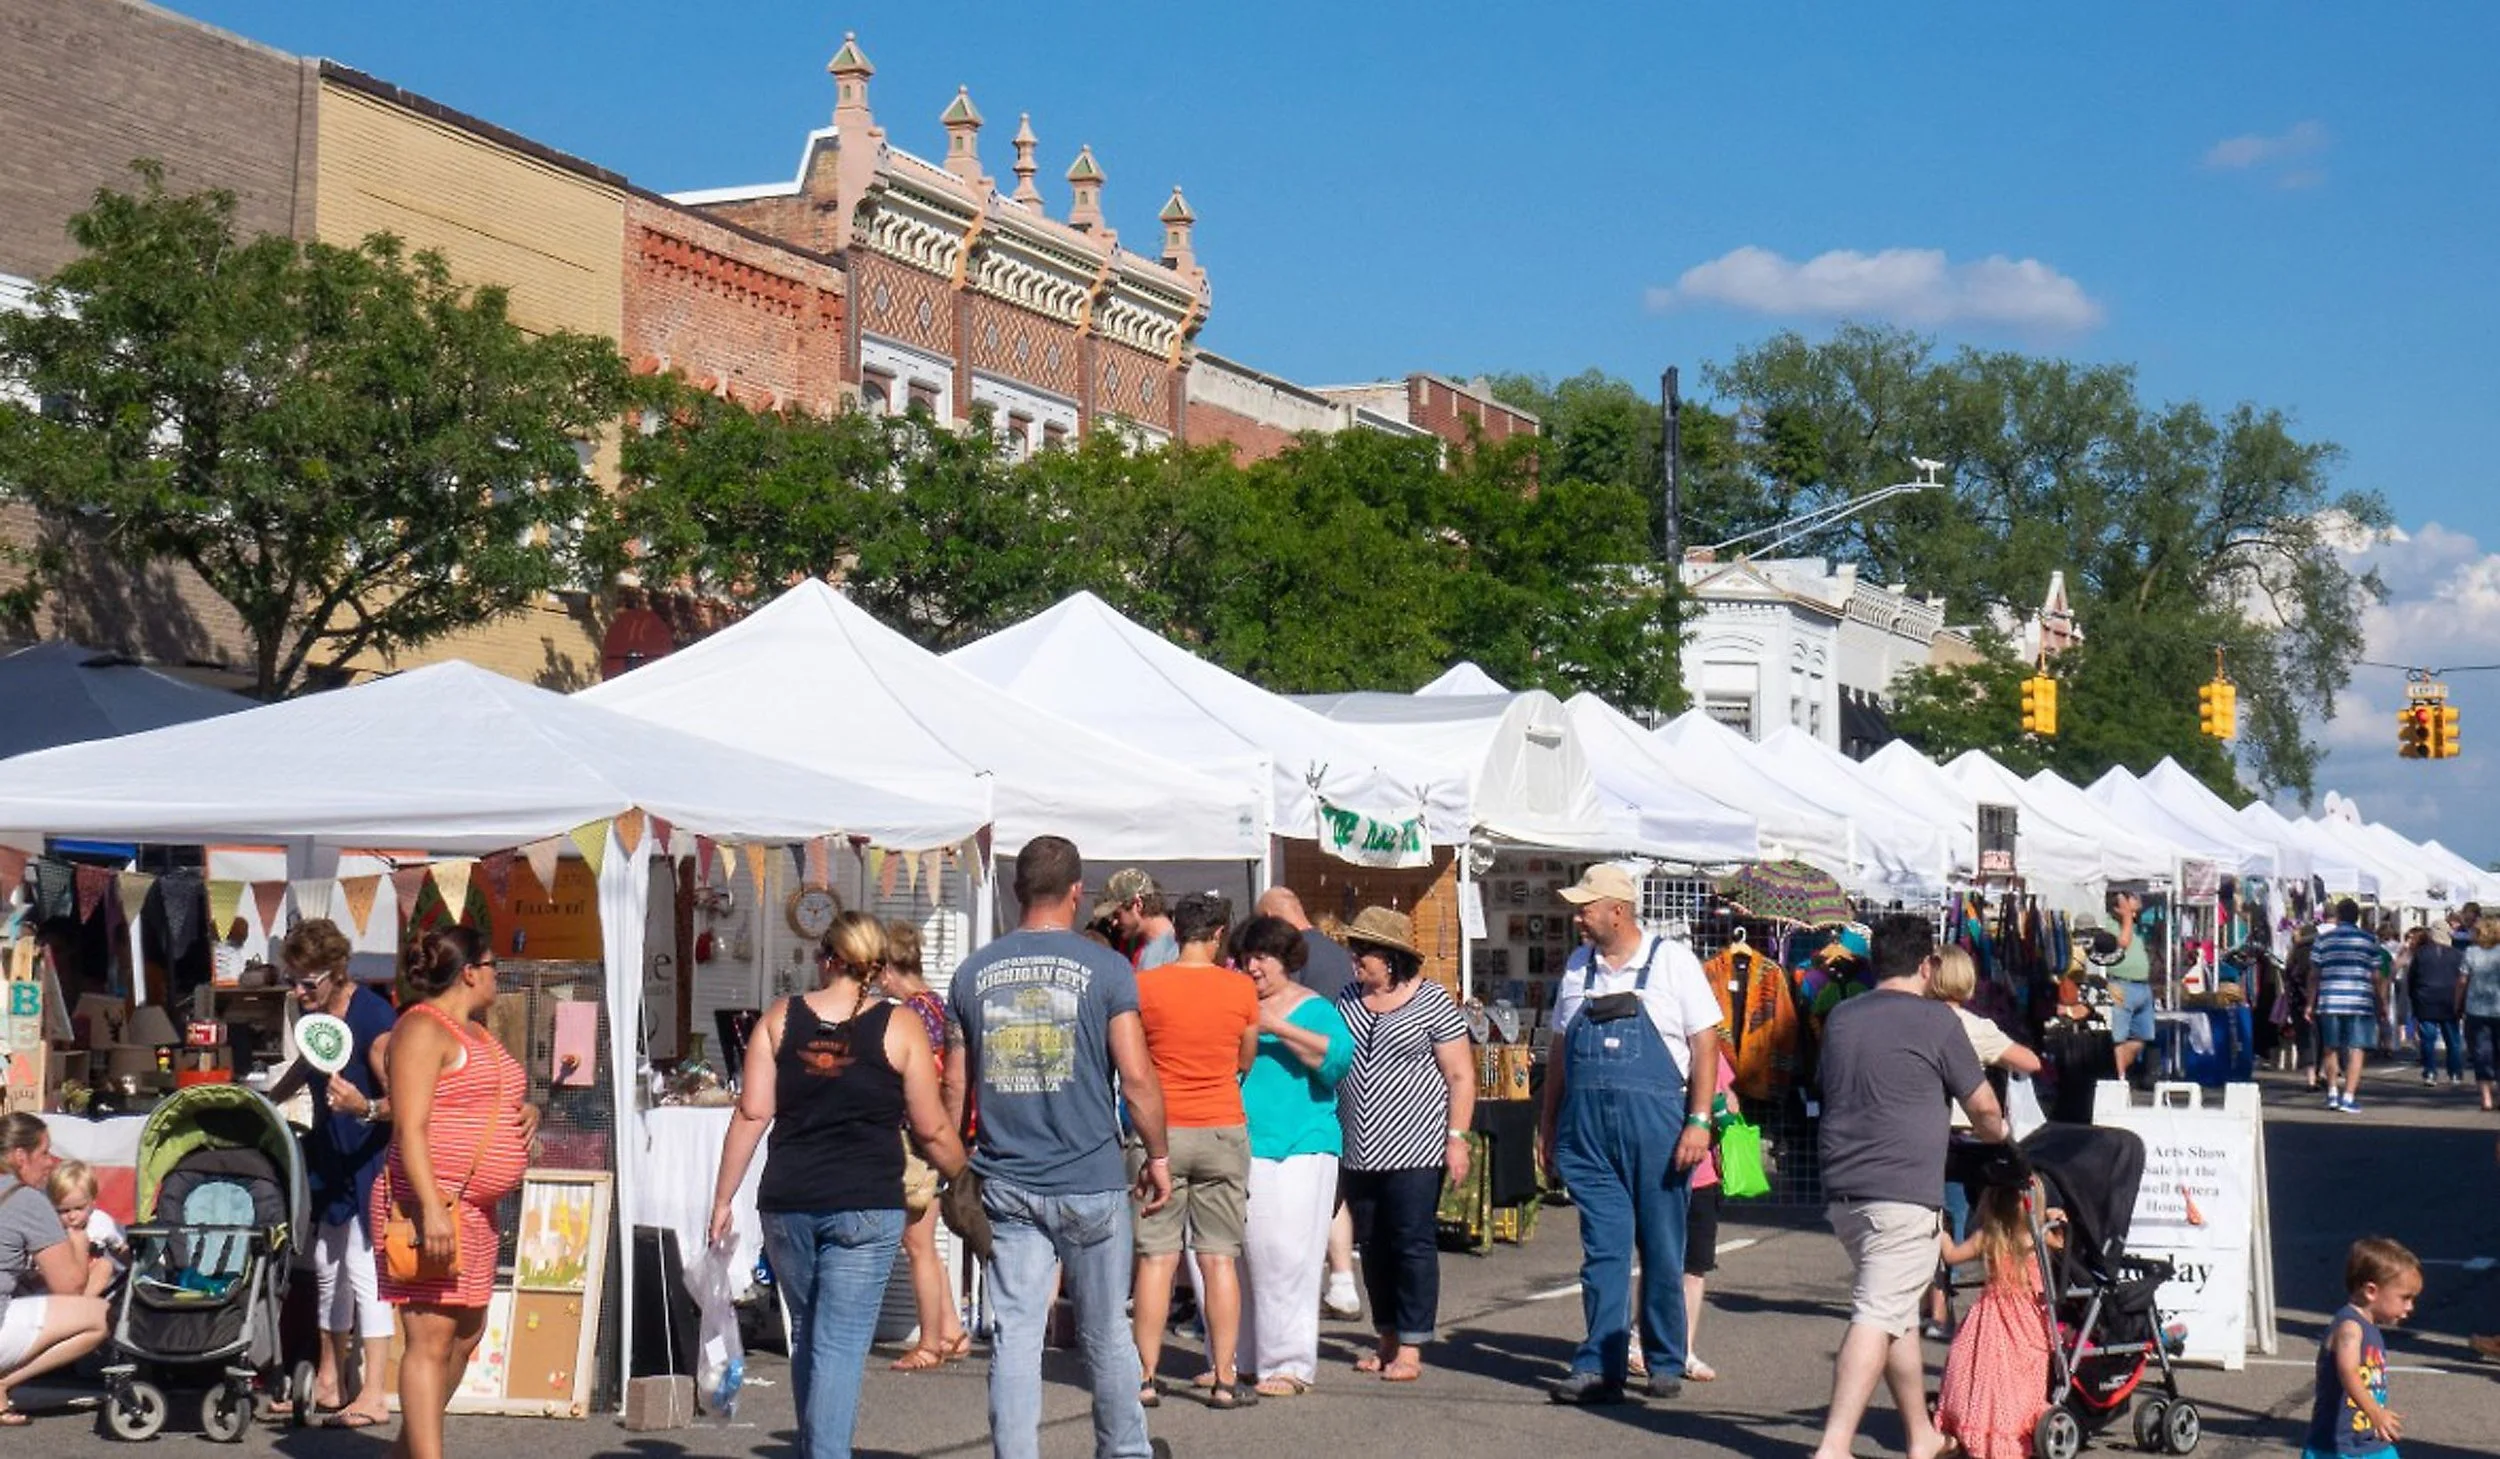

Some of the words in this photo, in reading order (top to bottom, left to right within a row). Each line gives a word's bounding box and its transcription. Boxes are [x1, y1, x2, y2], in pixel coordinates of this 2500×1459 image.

[976, 966, 1053, 994] MICHIGAN
[1056, 967, 1090, 993] CITY
[12, 984, 41, 1015] B
[8, 1055, 35, 1086] A
[2154, 1146, 2183, 1158] Arts
[2188, 1146, 2226, 1159] Show
[2195, 1165, 2217, 1177] the
[2141, 1182, 2170, 1195] well
[2146, 1199, 2186, 1213] Hous
